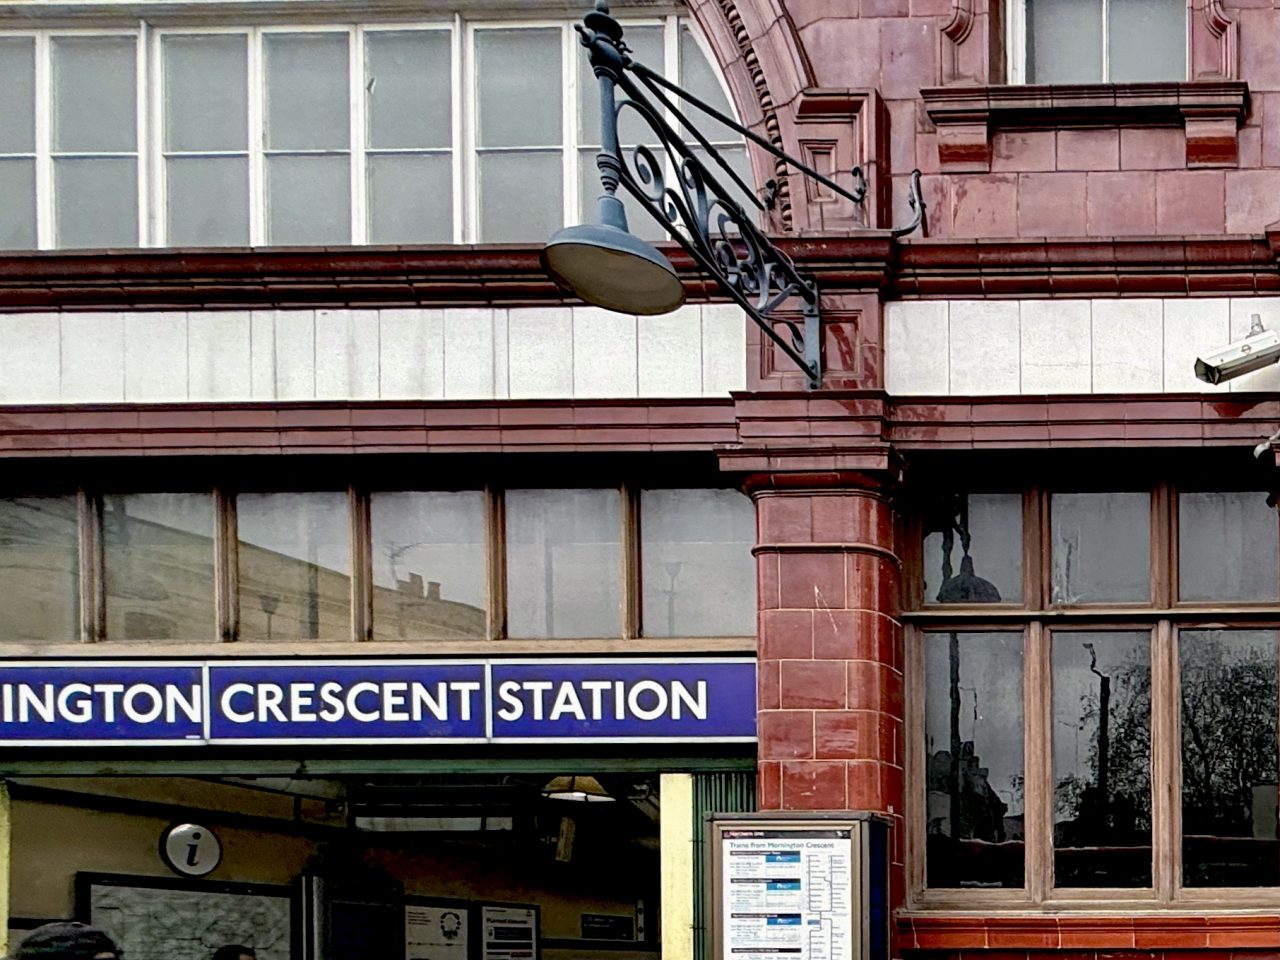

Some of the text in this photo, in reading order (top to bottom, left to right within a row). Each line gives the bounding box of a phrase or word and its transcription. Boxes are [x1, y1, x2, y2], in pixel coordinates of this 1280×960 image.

[3, 680, 707, 724] INGTON CRESCENT STATION
